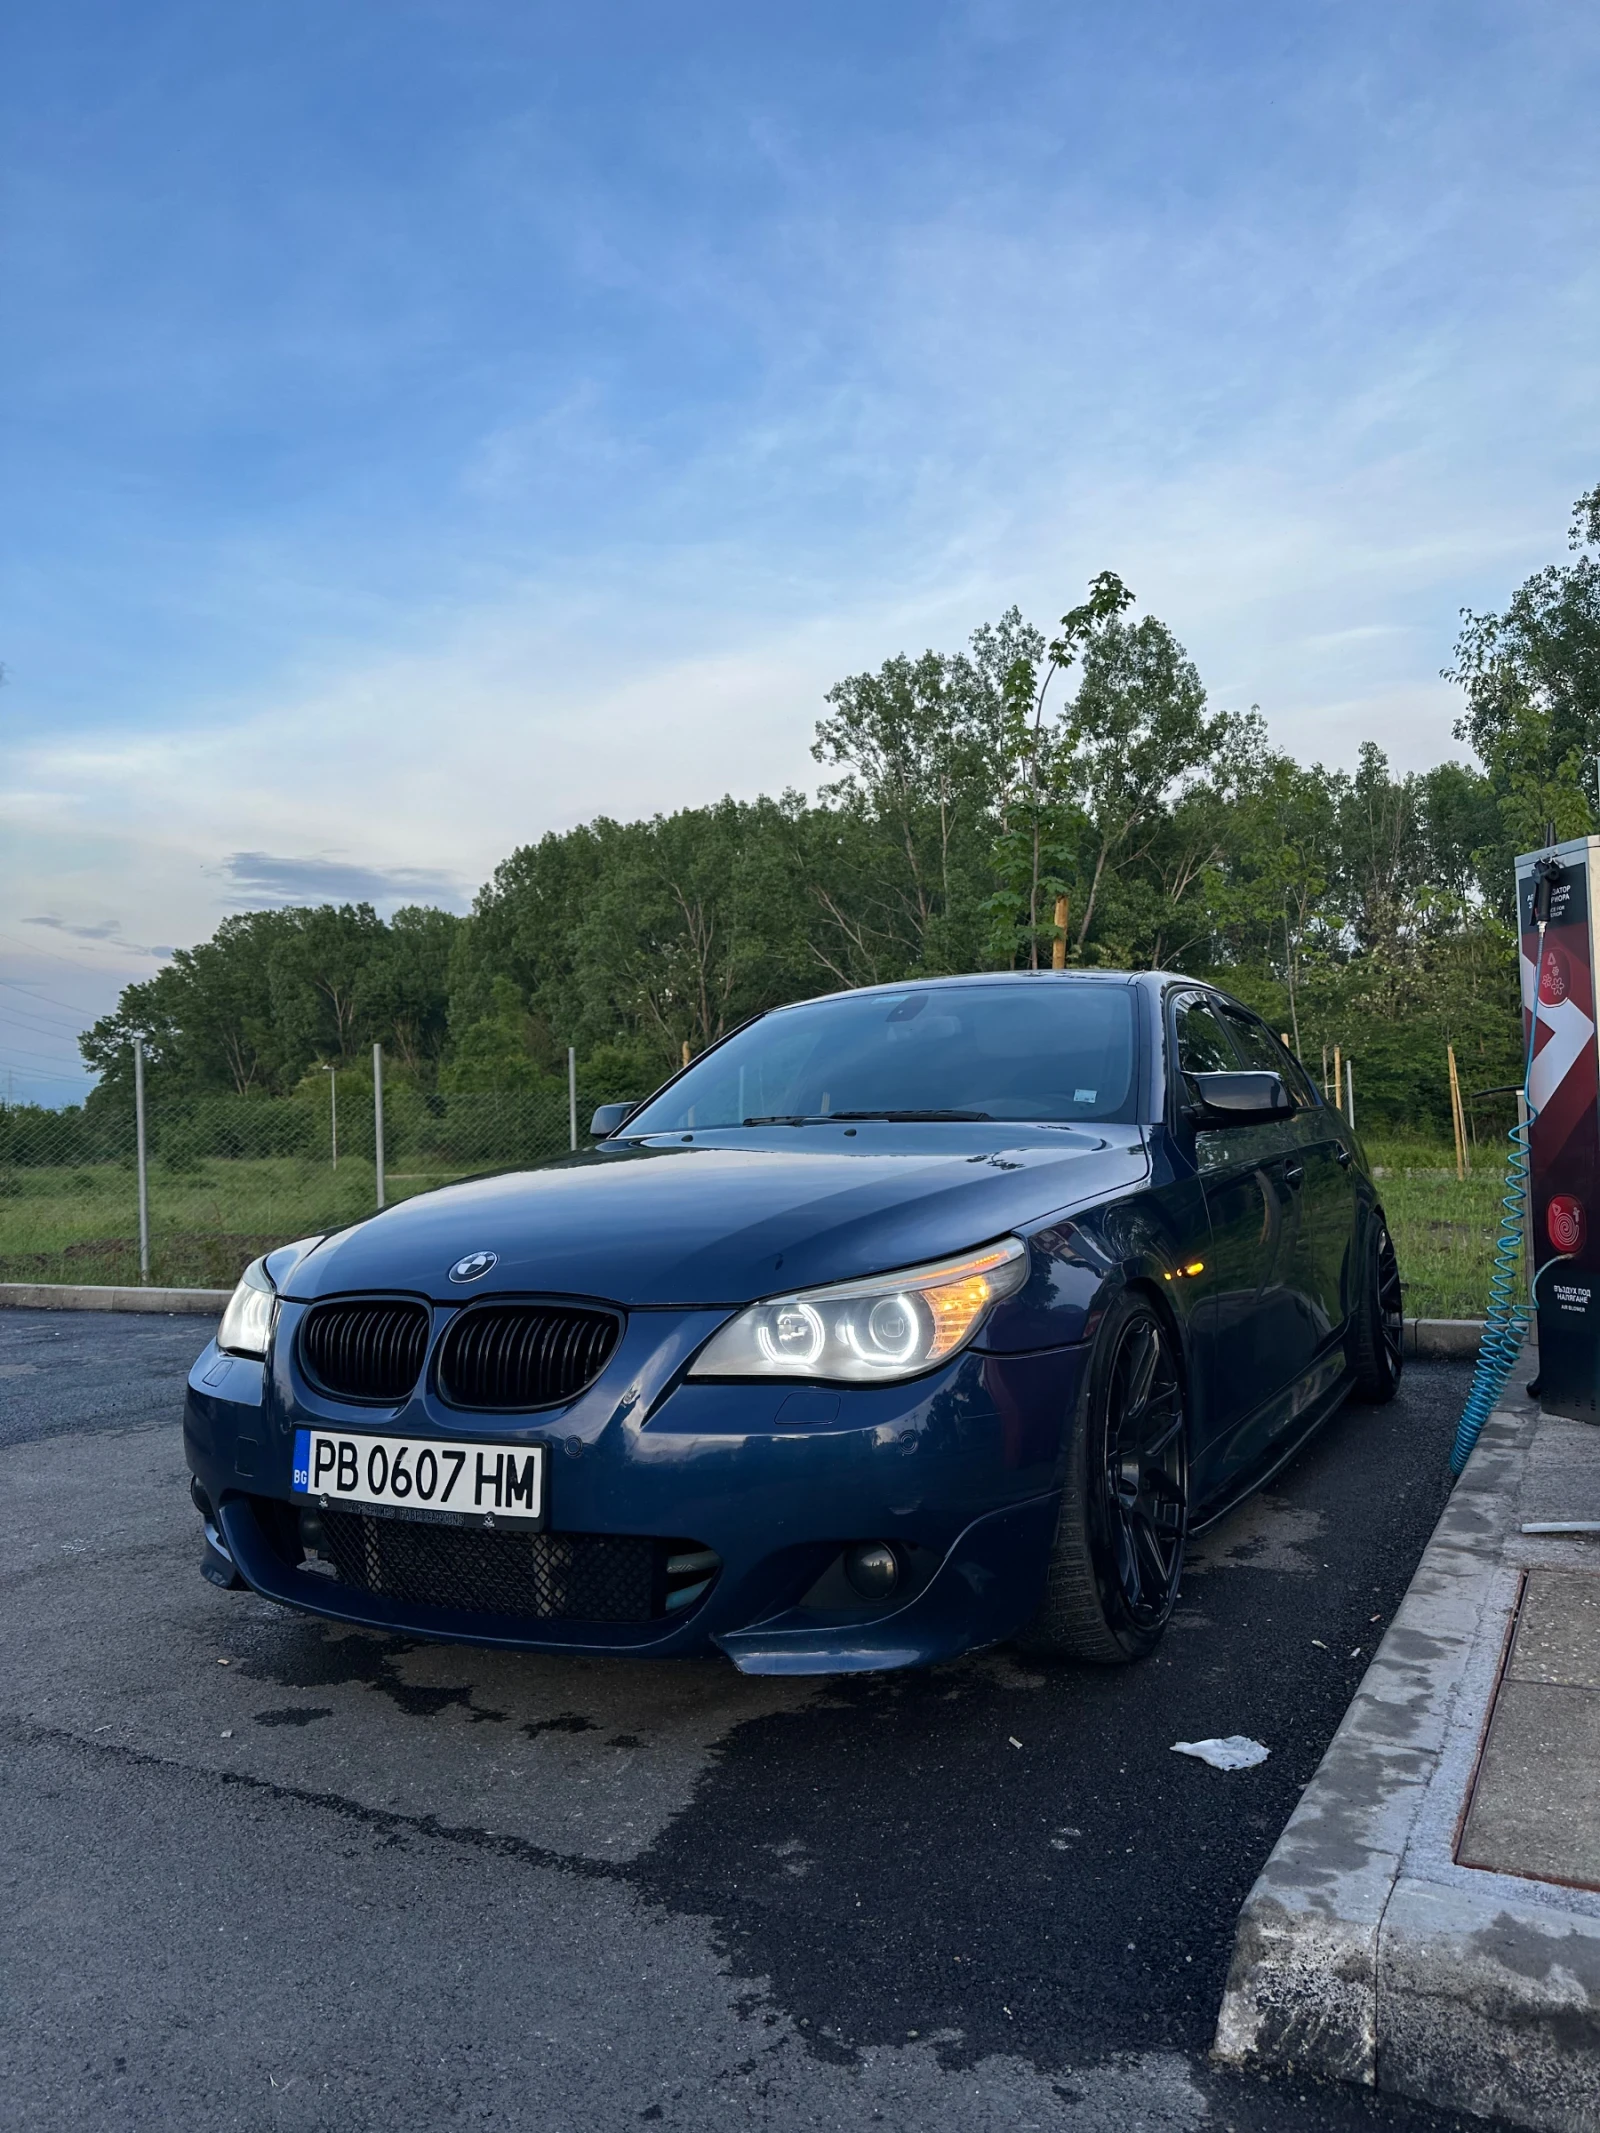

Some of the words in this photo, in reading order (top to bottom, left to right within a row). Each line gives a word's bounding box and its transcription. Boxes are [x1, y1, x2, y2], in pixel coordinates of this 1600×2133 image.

[1553, 1285, 1577, 1294] ВЪЗДУХ
[1578, 1288, 1591, 1297] ПОД
[1557, 1293, 1588, 1303] НАЛЯГАНЕ
[294, 1470, 307, 1485] BG
[314, 1438, 358, 1492] PB
[368, 1444, 466, 1503] 0607
[474, 1452, 535, 1510] HM
